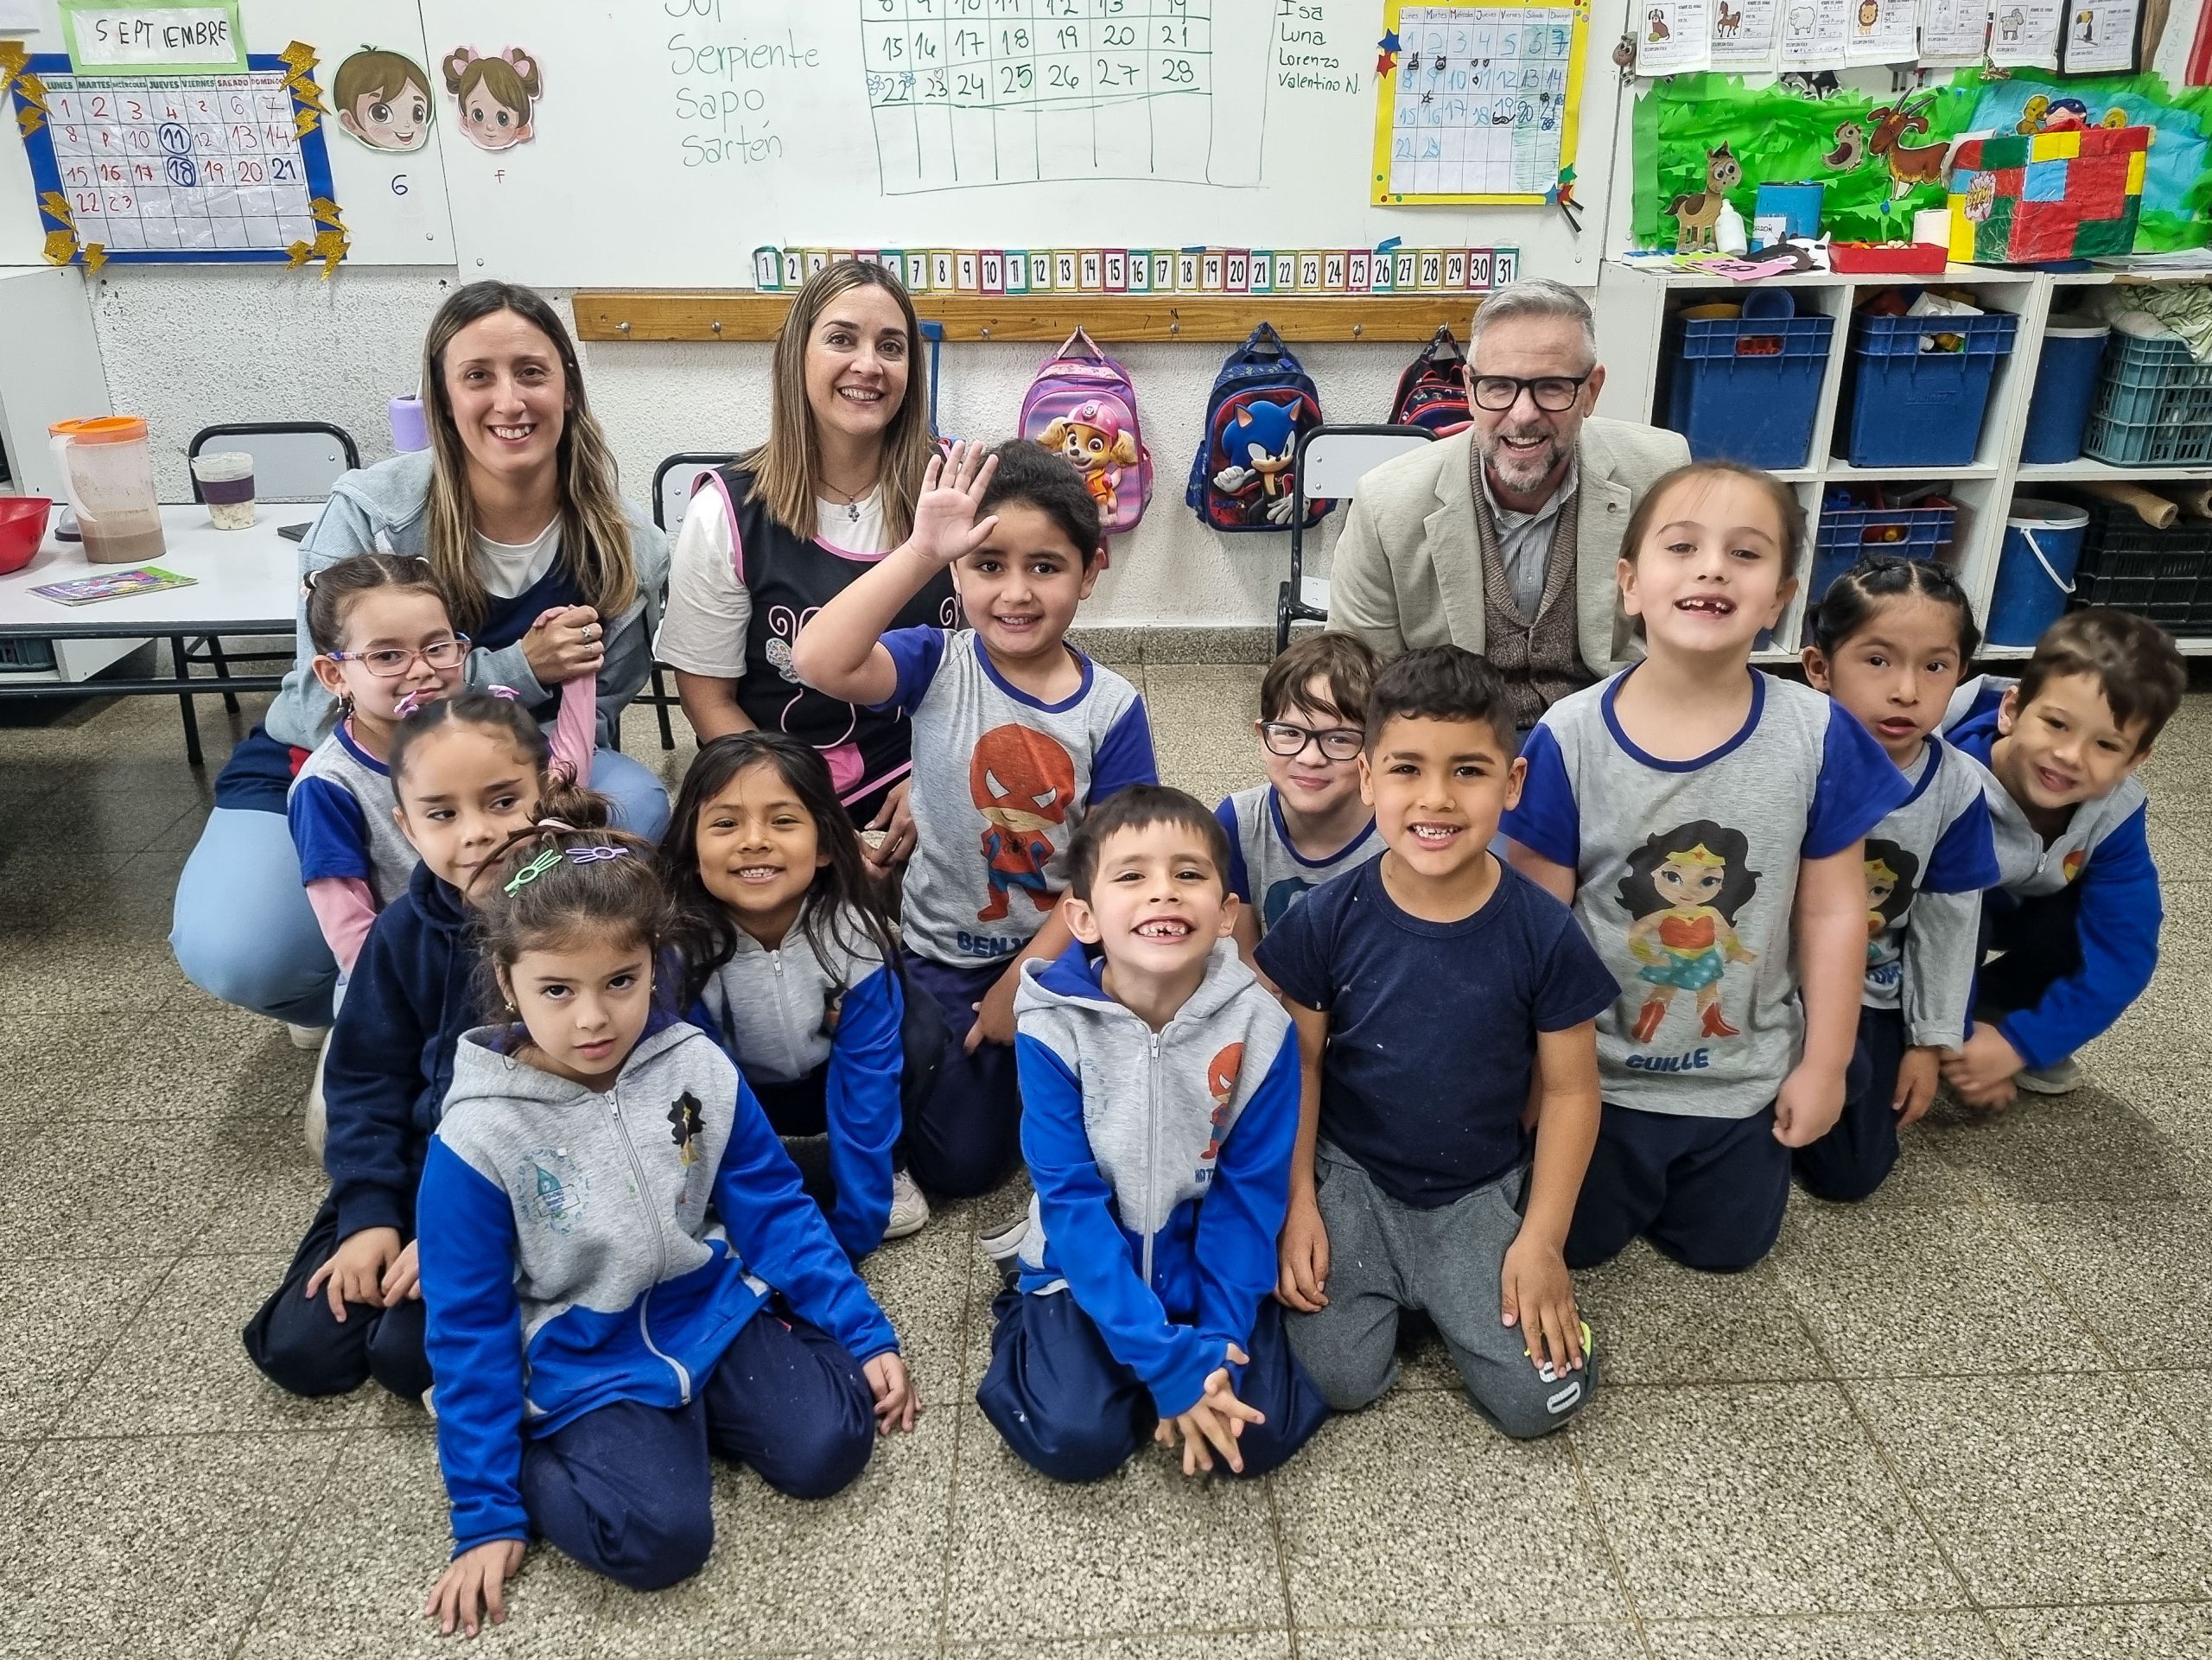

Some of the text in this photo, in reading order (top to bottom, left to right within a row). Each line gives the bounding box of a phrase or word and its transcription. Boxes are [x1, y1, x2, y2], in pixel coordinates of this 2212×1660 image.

[1277, 0, 1324, 20] Isa
[882, 25, 1187, 60] 15 16 17 18 19 20 21
[1281, 22, 1326, 45] Luna
[1406, 31, 1414, 49] 1
[1427, 32, 1443, 54] 2
[1452, 30, 1466, 53] 3
[1478, 31, 1491, 53] 4
[1501, 33, 1517, 55] 5
[667, 29, 820, 81] Serpiente
[1279, 47, 1339, 68] Lorenzo
[47, 81, 73, 90] LUNES
[78, 80, 111, 90] MARTES
[149, 80, 180, 89] JUEVES
[181, 80, 215, 88] VIERNES
[882, 59, 1193, 102] 22 23 24 25 26 27 28
[1278, 72, 1361, 94] Valentino N.
[1402, 69, 1414, 88] 8
[1448, 69, 1466, 91] 10
[1497, 70, 1519, 89] 12
[1521, 69, 1539, 88] 13
[1547, 67, 1562, 91] 14
[61, 99, 71, 118] 1
[92, 97, 109, 117] 2
[127, 100, 142, 119] 3
[166, 106, 178, 119] 4
[231, 96, 245, 114] 6
[263, 97, 285, 120] 7
[676, 87, 764, 133] Sapo
[1400, 107, 1416, 124] 15
[1422, 104, 1443, 124] 16
[1445, 99, 1467, 120] 17
[1518, 100, 1534, 123] 20
[66, 125, 77, 143] 8
[130, 130, 149, 149] 10
[164, 128, 185, 149] 11
[194, 132, 212, 147] 12
[232, 125, 257, 151] 13
[266, 124, 290, 148] 14
[682, 120, 782, 167] Sartén
[1395, 137, 1416, 158] 22
[67, 157, 296, 187] 15 16 17 18 19 20 21
[76, 192, 100, 213] 22
[761, 257, 769, 280] 1
[788, 258, 797, 280] 2
[912, 260, 920, 283] 7
[938, 260, 946, 283] 8
[963, 261, 972, 283] 9
[984, 260, 997, 283] 10
[1010, 259, 1019, 283] 11
[1033, 259, 1046, 282] 12
[1059, 259, 1071, 281] 13
[1084, 258, 1096, 281] 14
[1108, 258, 1121, 281] 15
[1132, 260, 1143, 283] 16
[1155, 260, 1168, 283] 17
[1181, 260, 1192, 283] 18
[1205, 260, 1217, 283] 19
[1230, 260, 1244, 283] 20
[1254, 261, 1266, 283] 21
[1279, 262, 1291, 283] 22
[1303, 262, 1317, 284] 23
[1327, 260, 1342, 283] 24
[1352, 260, 1365, 283] 25
[1375, 258, 1390, 283] 26
[1398, 258, 1412, 282] 27
[1423, 258, 1439, 282] 28
[1448, 258, 1462, 280] 29
[1471, 258, 1488, 281] 30
[1497, 258, 1511, 283] 31
